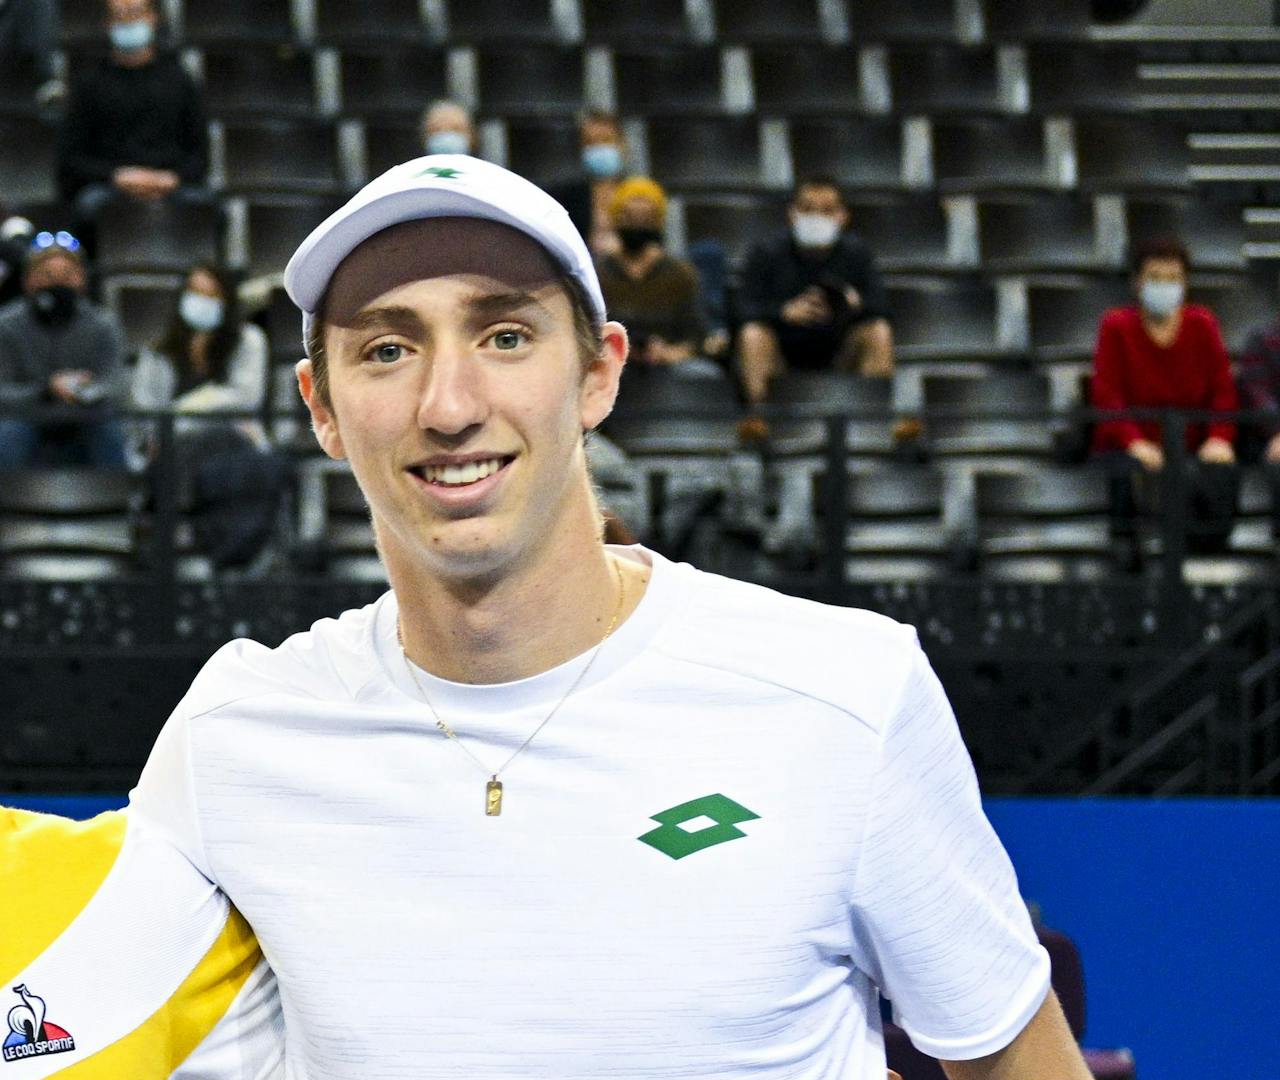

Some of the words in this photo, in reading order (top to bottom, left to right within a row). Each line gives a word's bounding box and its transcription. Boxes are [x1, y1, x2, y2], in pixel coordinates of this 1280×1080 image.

[4, 1047, 16, 1060] LE
[16, 1043, 36, 1057] COQ
[36, 1037, 74, 1053] SPORTIF
